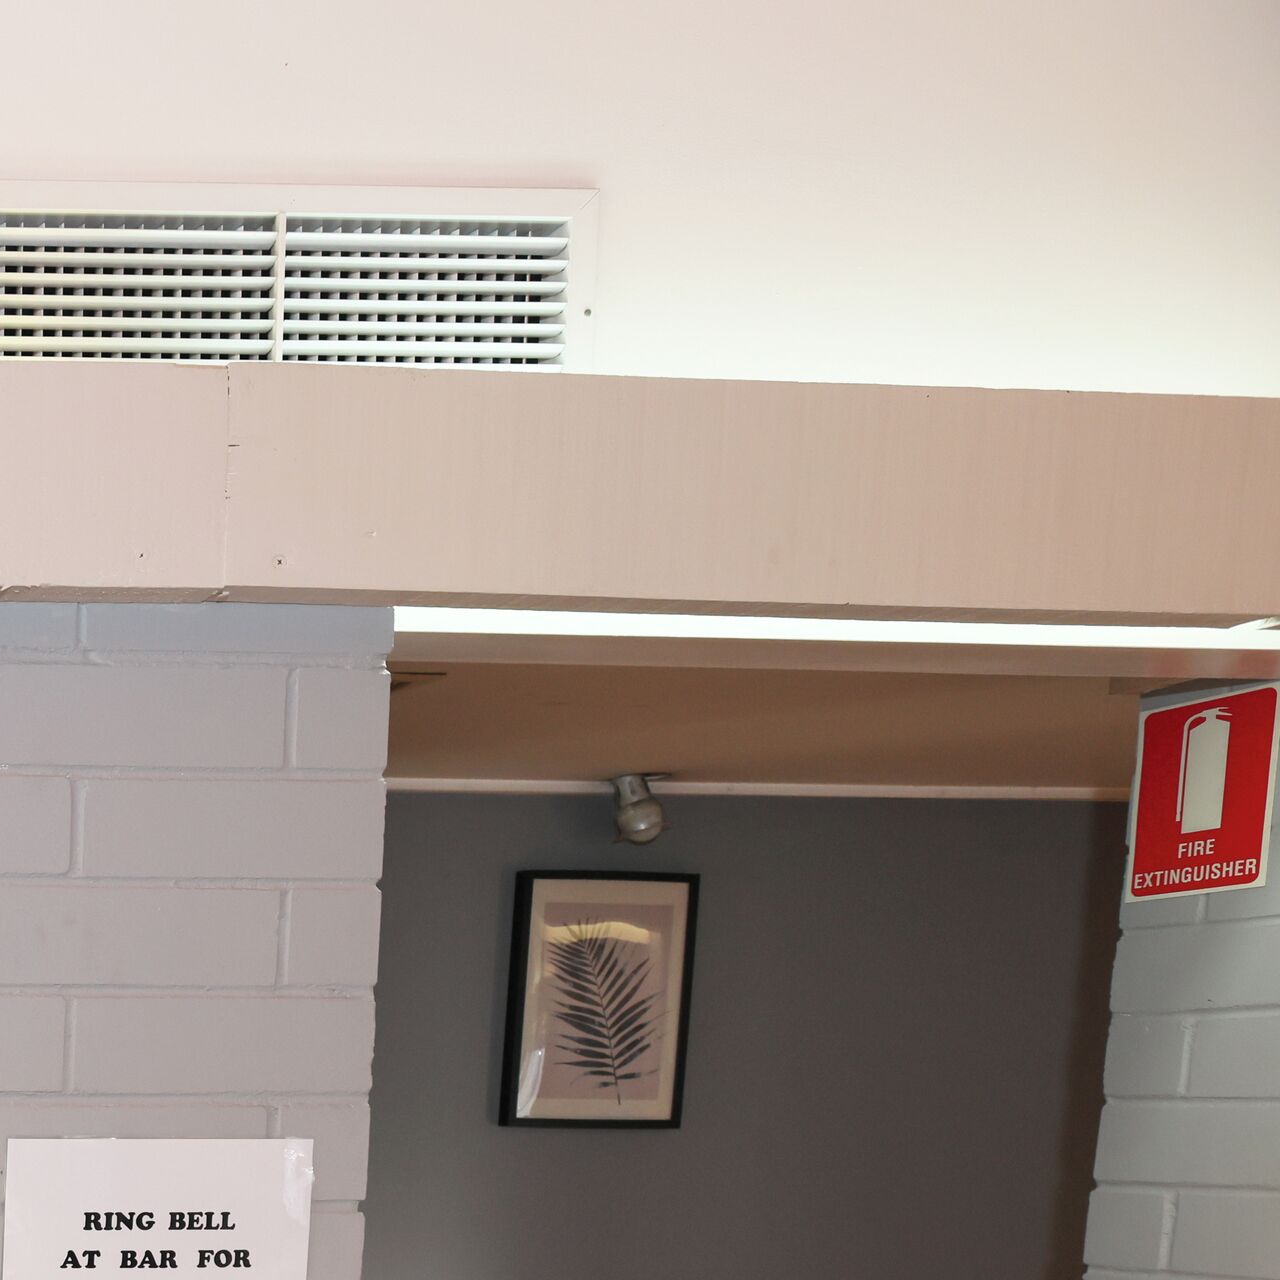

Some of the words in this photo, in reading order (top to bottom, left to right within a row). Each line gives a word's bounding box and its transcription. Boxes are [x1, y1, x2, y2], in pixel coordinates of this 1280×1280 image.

[1177, 838, 1216, 859] FIRE
[1134, 859, 1256, 889] EXTINGUISHER
[83, 1211, 156, 1231] RING
[168, 1211, 236, 1231] BELL
[60, 1249, 101, 1269] AT
[119, 1249, 178, 1269] BAR
[196, 1249, 252, 1268] FOR
